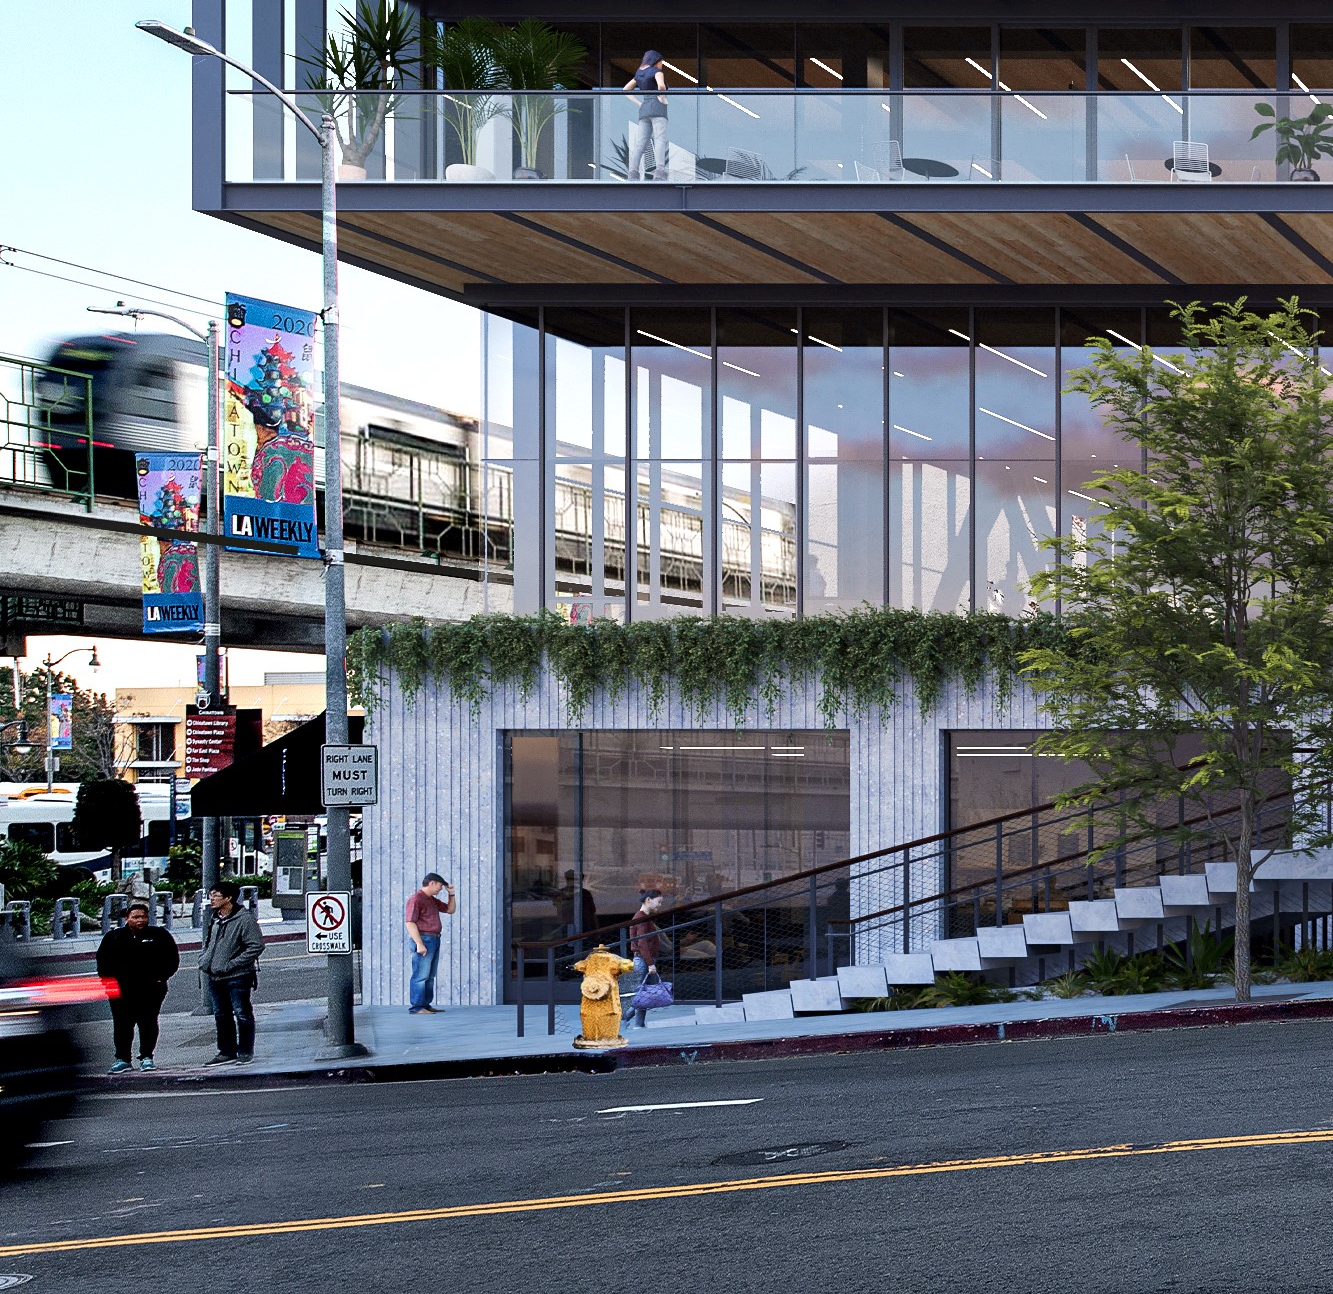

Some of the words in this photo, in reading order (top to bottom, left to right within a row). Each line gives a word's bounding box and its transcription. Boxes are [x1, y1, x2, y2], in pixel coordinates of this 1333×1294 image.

[272, 314, 313, 338] 2020
[169, 459, 200, 471] 2020
[326, 755, 349, 764] RIGHT
[352, 755, 373, 764] LANE
[332, 770, 367, 781] MUST
[327, 787, 348, 796] TURN
[351, 787, 373, 796] RIGHT
[328, 932, 343, 941] USE
[311, 942, 346, 950] CROSSWALK
